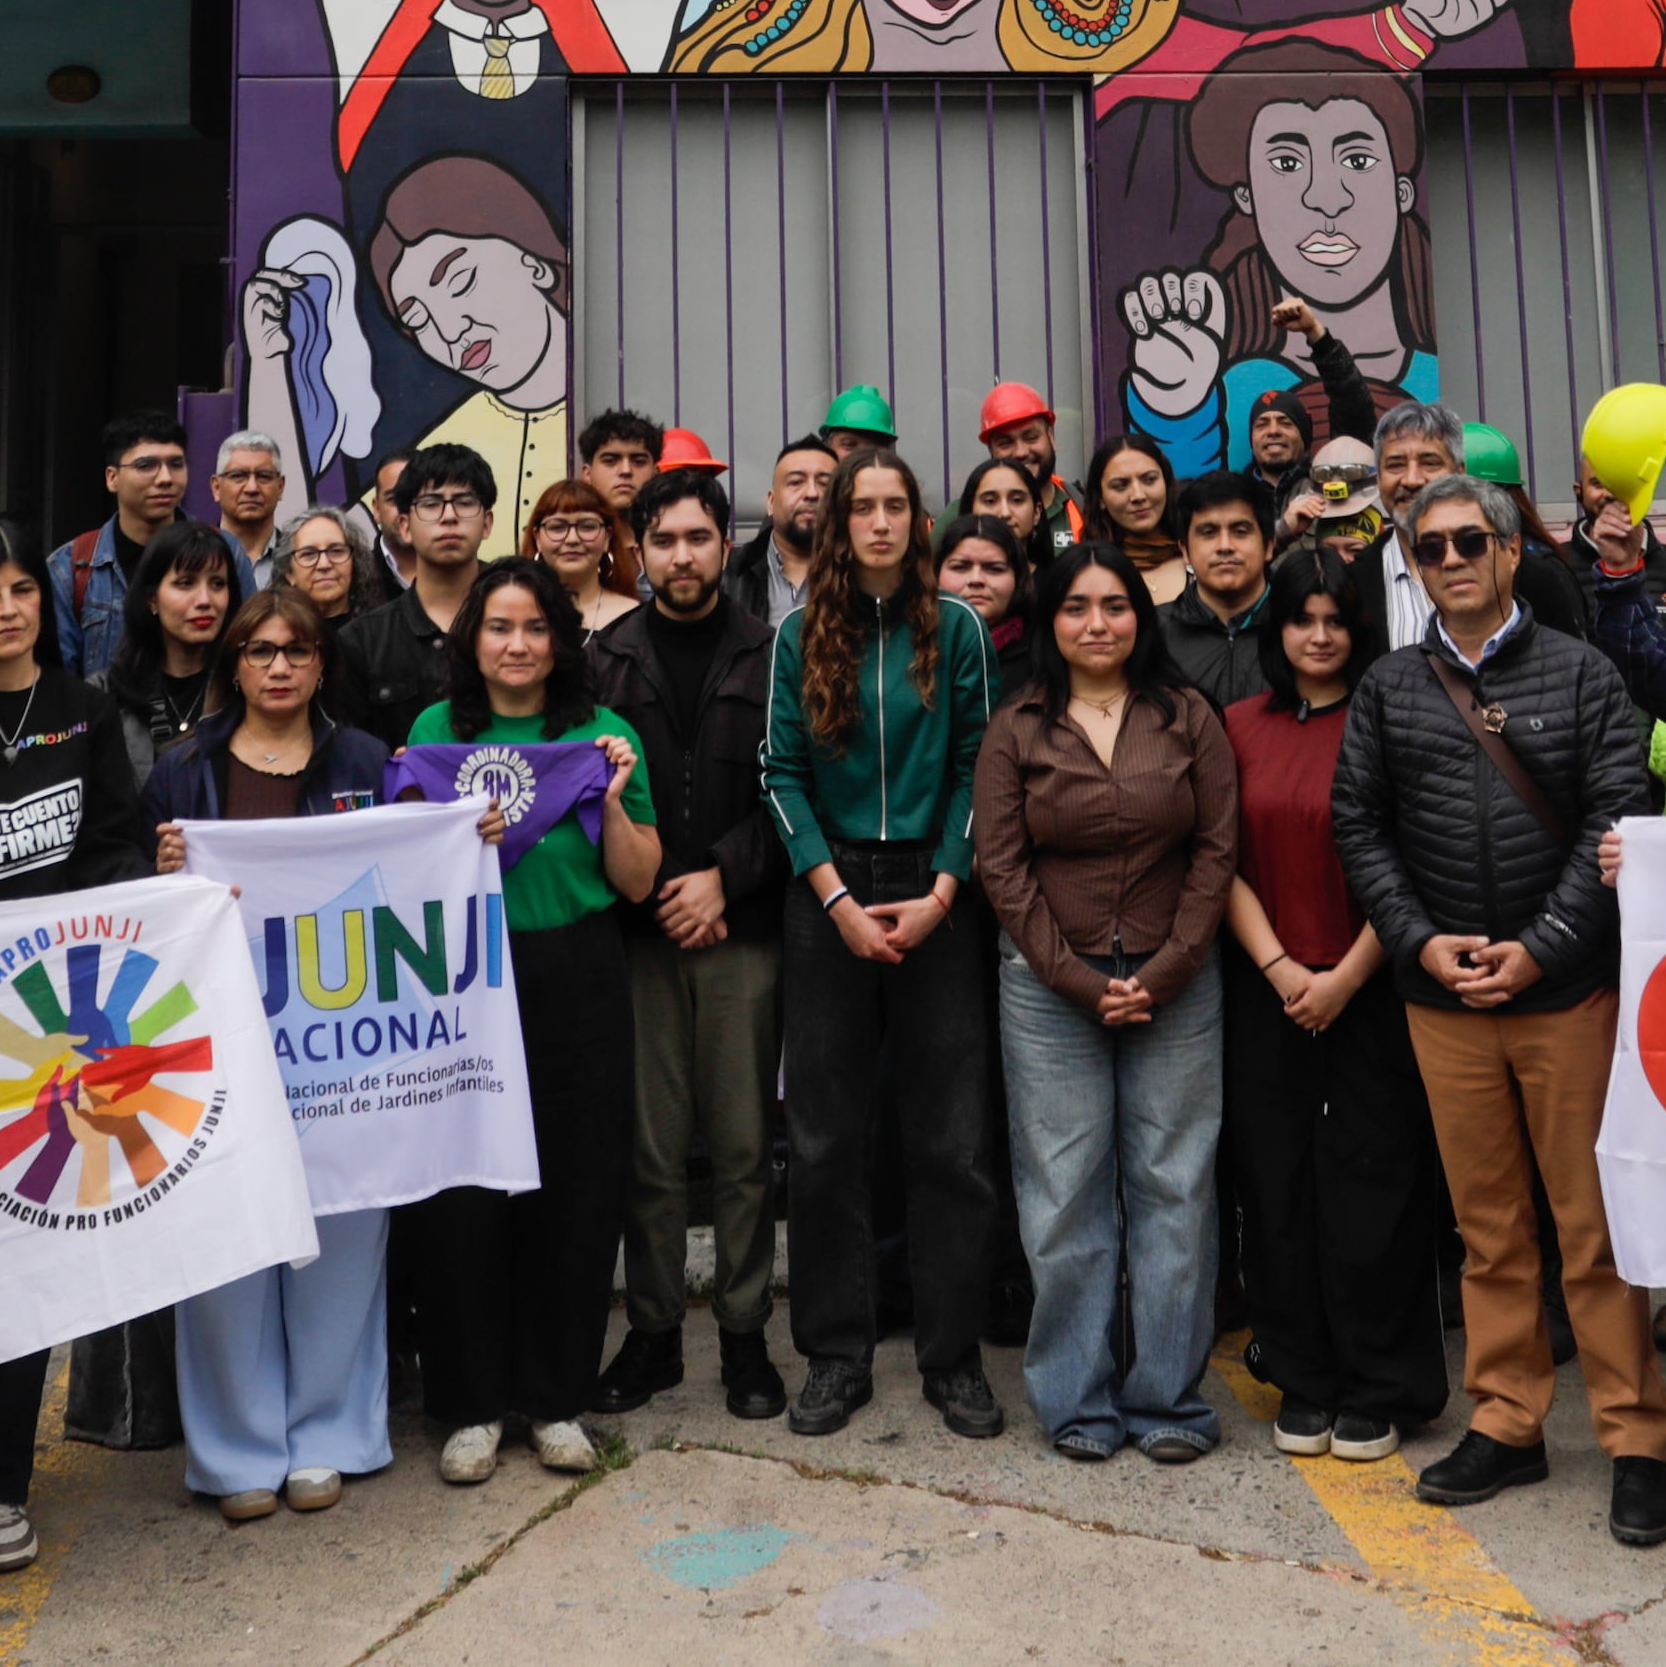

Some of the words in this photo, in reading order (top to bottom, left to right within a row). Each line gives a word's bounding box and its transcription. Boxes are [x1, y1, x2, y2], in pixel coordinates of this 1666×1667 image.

[454, 746, 536, 793] COORDINADORA
[10, 789, 80, 829] CUENTO
[262, 893, 502, 1018] JUNJI
[274, 1006, 467, 1065] ACIONAL
[291, 1096, 345, 1121] cional
[350, 1096, 371, 1114] de
[377, 1087, 443, 1111] Jardines
[363, 1075, 380, 1091] de
[65, 1213, 97, 1230] PRO
[104, 1137, 208, 1227] FUNCIONARIOS
[201, 1089, 228, 1136] JUNJI
